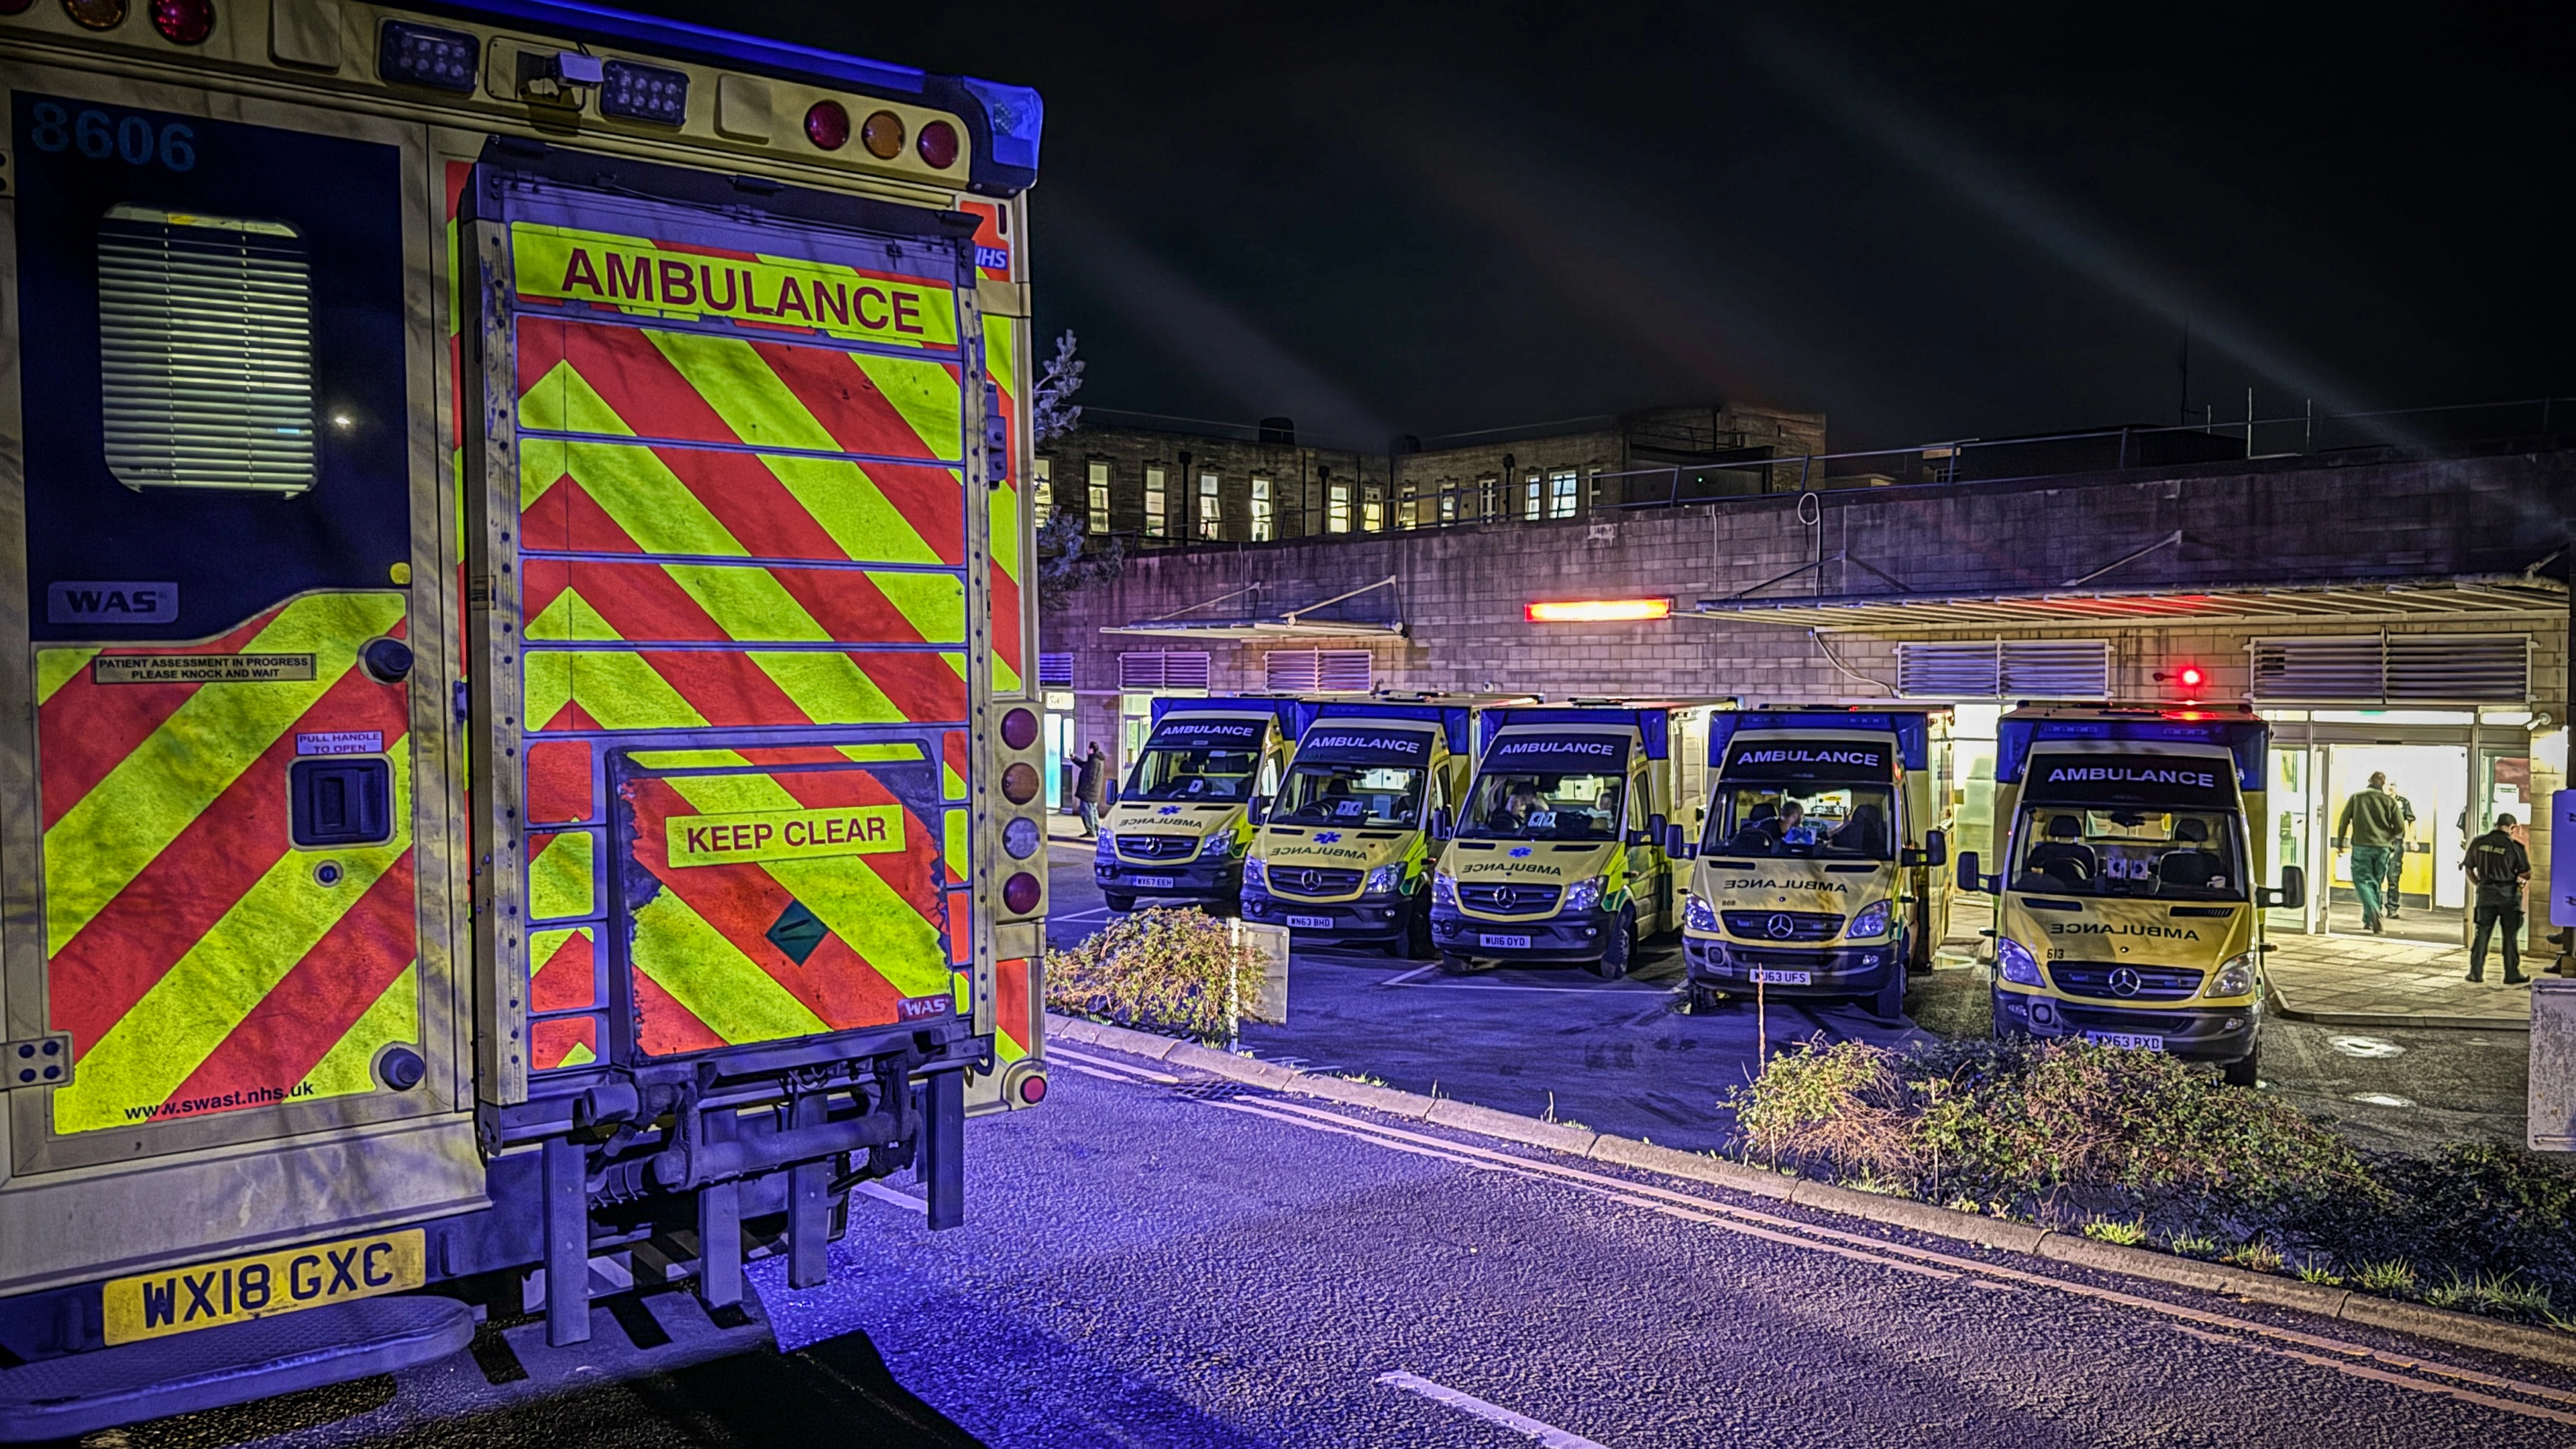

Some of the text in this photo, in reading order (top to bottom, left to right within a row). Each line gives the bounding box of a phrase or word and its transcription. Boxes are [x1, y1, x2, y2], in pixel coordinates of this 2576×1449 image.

[31, 101, 197, 172] 8606
[561, 248, 925, 335] AMBULANCE
[66, 590, 156, 613] WAS
[99, 657, 308, 668] PATIENT ASSESSMENT IN PROGRESS
[131, 669, 280, 679] PLEASE KNOCK AND WAIT
[333, 733, 380, 741] HANDLE
[1161, 724, 1254, 737] AMBULANCE
[333, 745, 366, 753] OPEN
[1307, 736, 1419, 753] AMBULANCE
[1499, 743, 1614, 756] AMBULANCE
[1737, 750, 1879, 766] AMBULANCE
[2048, 767, 2214, 788] AMBULANCE
[687, 816, 887, 853] KEEP CLEAR
[1291, 917, 1330, 927] WN63 BHD
[1485, 936, 1505, 945] WU16
[2047, 949, 2064, 959] 613
[1784, 973, 1806, 982] UFS
[905, 999, 945, 1016] WAS
[125, 1081, 314, 1120] www.swast.nhs.uk
[143, 1242, 392, 1329] WX18 GXC
